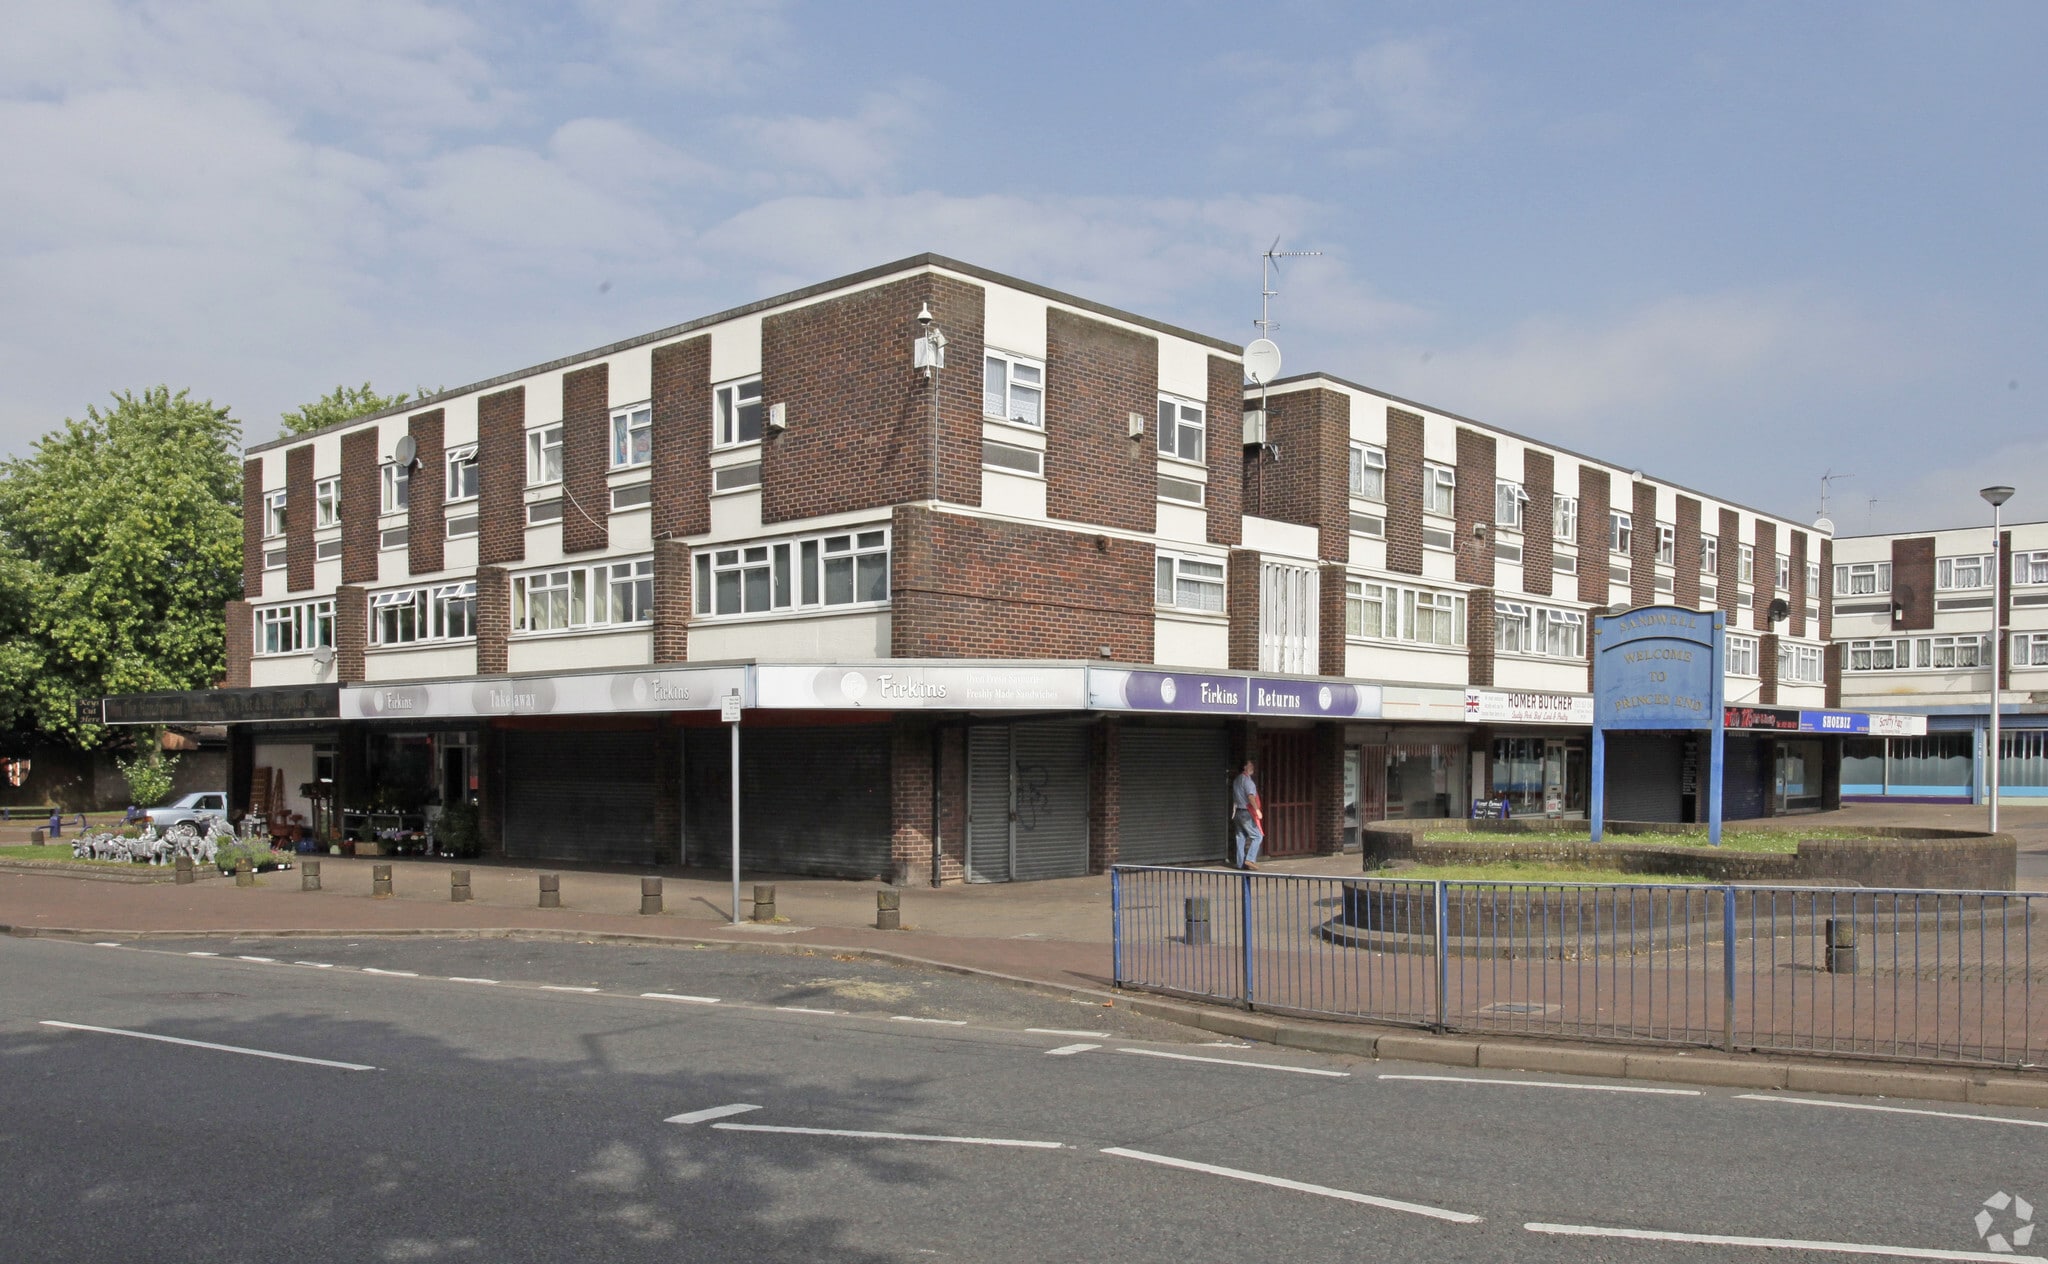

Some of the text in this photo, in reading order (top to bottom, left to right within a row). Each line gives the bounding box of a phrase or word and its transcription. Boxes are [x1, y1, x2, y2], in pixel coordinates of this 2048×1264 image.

[1620, 614, 1697, 631] SANDWELL
[1624, 649, 1693, 664] WELCOME
[1648, 672, 1667, 682] TO
[651, 679, 690, 701] Firkins
[877, 674, 947, 699] Firkins
[1200, 683, 1238, 705] Firkins
[80, 699, 99, 708] Keys
[386, 692, 412, 710] Firkins
[1257, 688, 1301, 708] Returns
[1508, 692, 1536, 708] HOMER
[1539, 694, 1573, 711] BUTCHER
[1615, 694, 1703, 711] PRINCES END
[1822, 716, 1851, 729] SHOEBIZ
